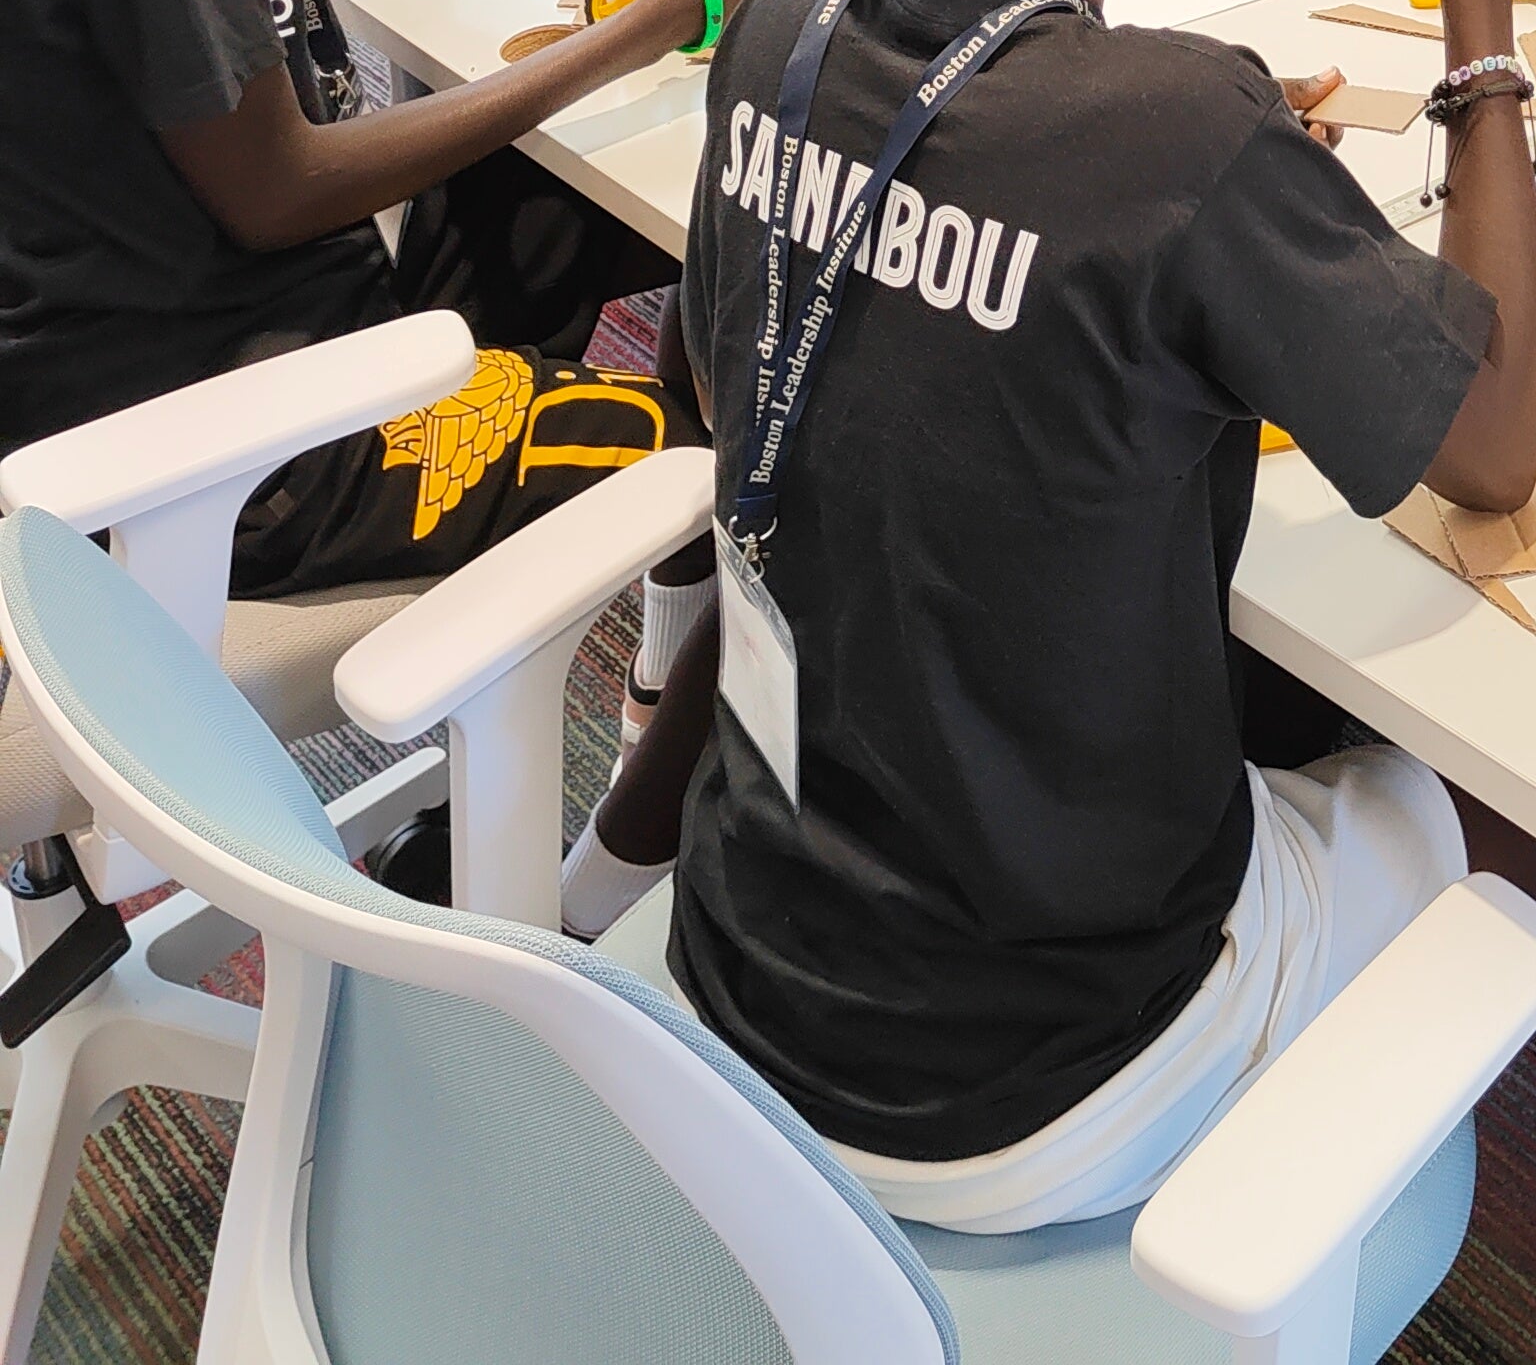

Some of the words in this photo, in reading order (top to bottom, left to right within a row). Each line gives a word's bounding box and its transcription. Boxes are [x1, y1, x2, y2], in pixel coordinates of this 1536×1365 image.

[916, 33, 987, 109] Boston
[773, 134, 799, 220] Boston
[749, 408, 784, 485] Boston
[778, 292, 834, 416] Leadership
[816, 200, 869, 297] Institute
[757, 223, 788, 361] Leadership
